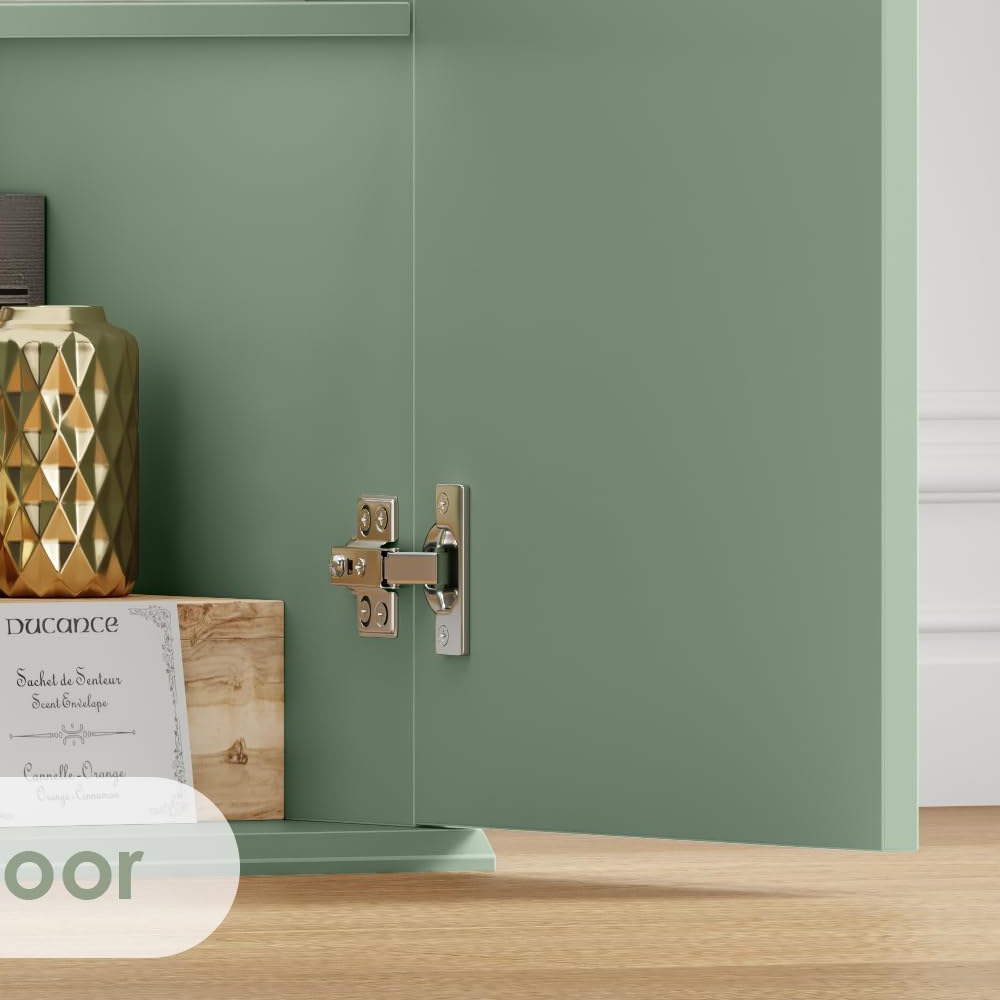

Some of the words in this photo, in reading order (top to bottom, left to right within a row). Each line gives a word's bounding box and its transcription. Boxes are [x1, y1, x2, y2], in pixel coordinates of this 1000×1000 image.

[16, 667, 58, 687] Sachet
[60, 672, 74, 686] de
[75, 666, 122, 686] Senteur
[32, 692, 60, 710] Scent
